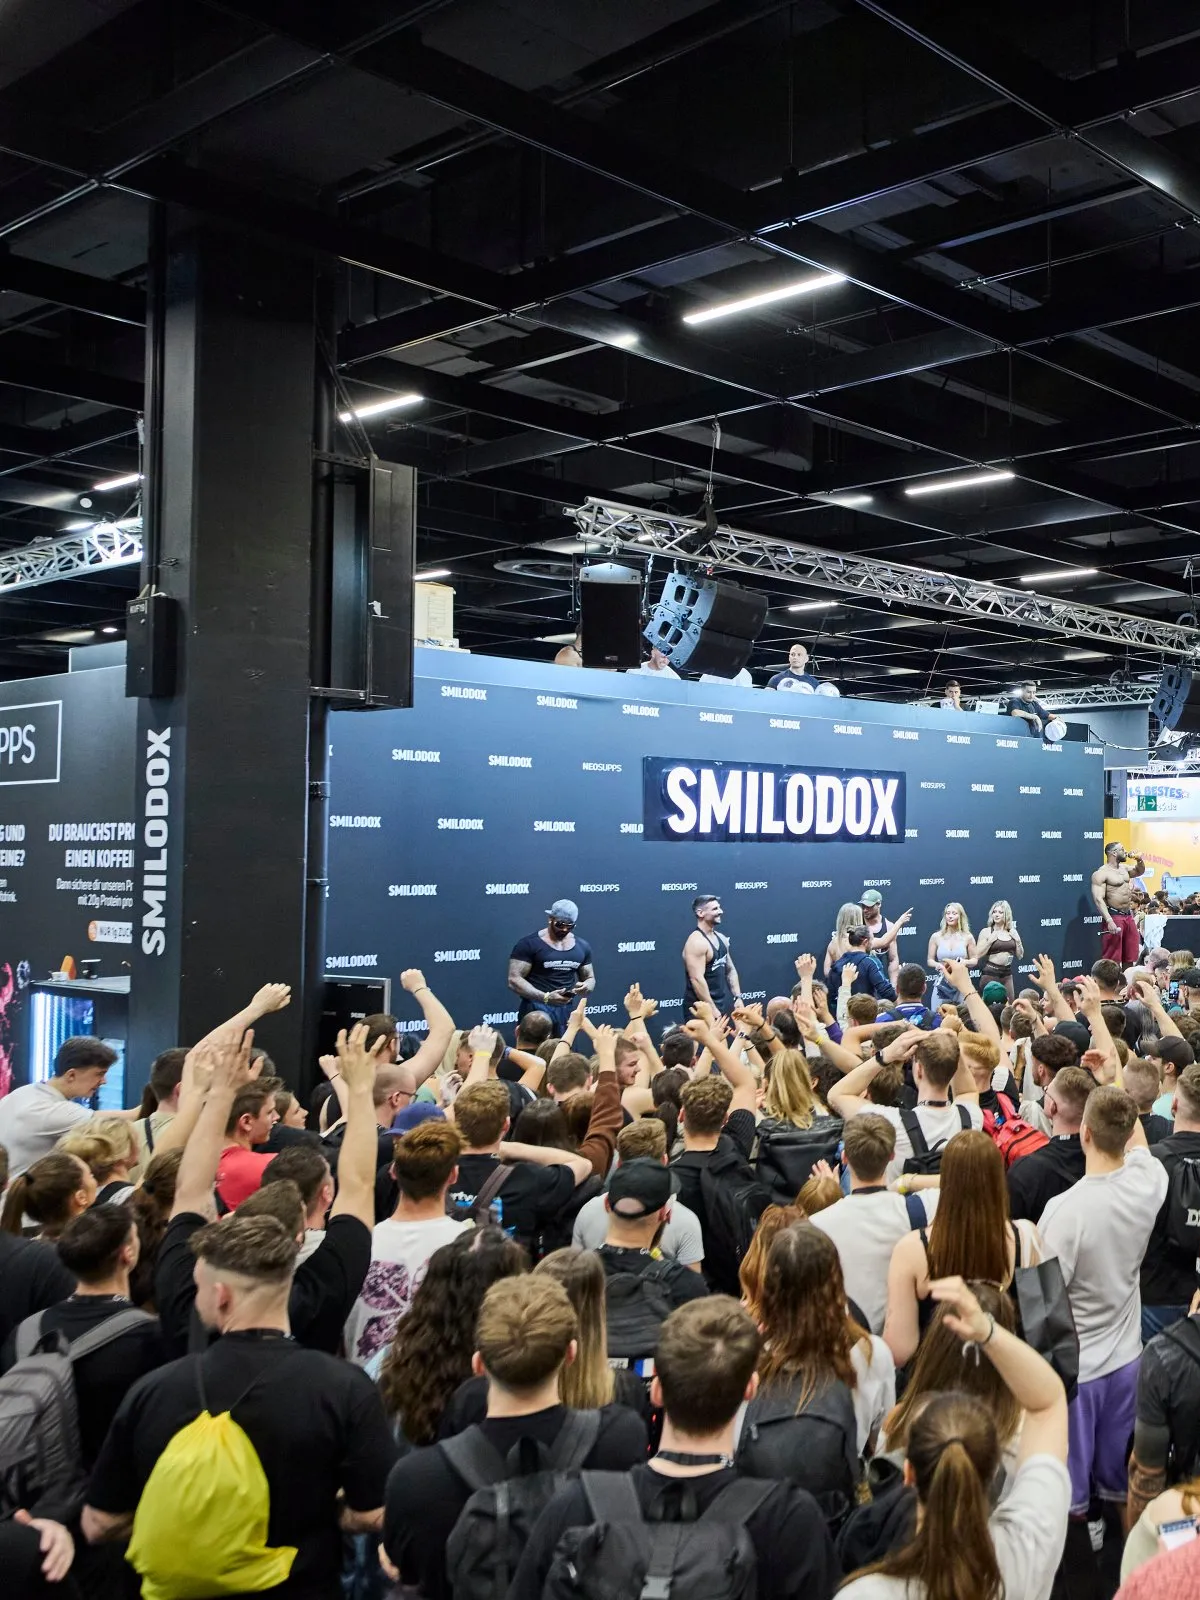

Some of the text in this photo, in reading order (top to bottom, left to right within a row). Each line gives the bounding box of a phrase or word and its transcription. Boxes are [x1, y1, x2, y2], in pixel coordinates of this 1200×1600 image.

[441, 686, 487, 701] SMILODOX
[536, 695, 578, 709] SMILODOX
[622, 704, 660, 717] SMILODOX
[699, 711, 733, 724] SMILODOX
[769, 718, 801, 730] SMILODOX
[833, 724, 863, 735] SMILODOX
[892, 729, 919, 741] SMILODOX
[946, 734, 971, 745] SMILODOX
[996, 738, 1019, 749] SMILODOX
[391, 748, 441, 762] SMILODOX
[1084, 746, 1104, 755] SMILODOX
[488, 754, 532, 768] SMILODOX
[582, 762, 623, 773] NEOSUPPS
[920, 780, 946, 790] NEOSUPPS
[970, 783, 995, 793] SMILODOX
[1019, 785, 1042, 795] SMILODOX
[1063, 788, 1084, 797] SMILODOX
[666, 766, 899, 836] SMILODOX
[329, 814, 382, 829] SMILODOX
[437, 817, 484, 831] SMILODOX
[533, 820, 576, 833] SMILODOX
[6, 824, 26, 842] UND
[49, 824, 63, 841] DU
[64, 822, 117, 841] BRAUCHST
[945, 829, 970, 839] SMILODOX
[995, 829, 1018, 839] SMILODOX
[1041, 830, 1063, 839] SMILODOX
[1084, 831, 1104, 840] SMILODOX
[141, 727, 171, 956] SMILODOX
[65, 849, 96, 868] EINEN
[863, 878, 892, 887] NEOSUPPS
[919, 877, 945, 886] NEOSUPPS
[970, 875, 994, 885] SMILODOX
[1018, 874, 1041, 884] SMILODOX
[1062, 873, 1083, 882] SMILODOX
[485, 883, 530, 895] SMILODOX
[579, 883, 620, 893] NEOSUPPS
[661, 882, 698, 892] NEOSUPPS
[734, 881, 768, 889] NEOSUPPS
[801, 880, 833, 888] NEOSUPPS
[388, 884, 438, 897] SMILODOX
[78, 894, 88, 906] mit
[1040, 917, 1062, 927] SMILODOX
[766, 933, 799, 944] SMILODOX
[618, 940, 656, 953] SMILODOX
[325, 953, 378, 969] SMILODOX
[434, 949, 481, 963] SMILODOX
[1062, 959, 1083, 969] SMILODOX
[969, 970, 982, 979] SMIL
[740, 990, 766, 1000] OSUPPS
[584, 1004, 618, 1015] EOSUPPS
